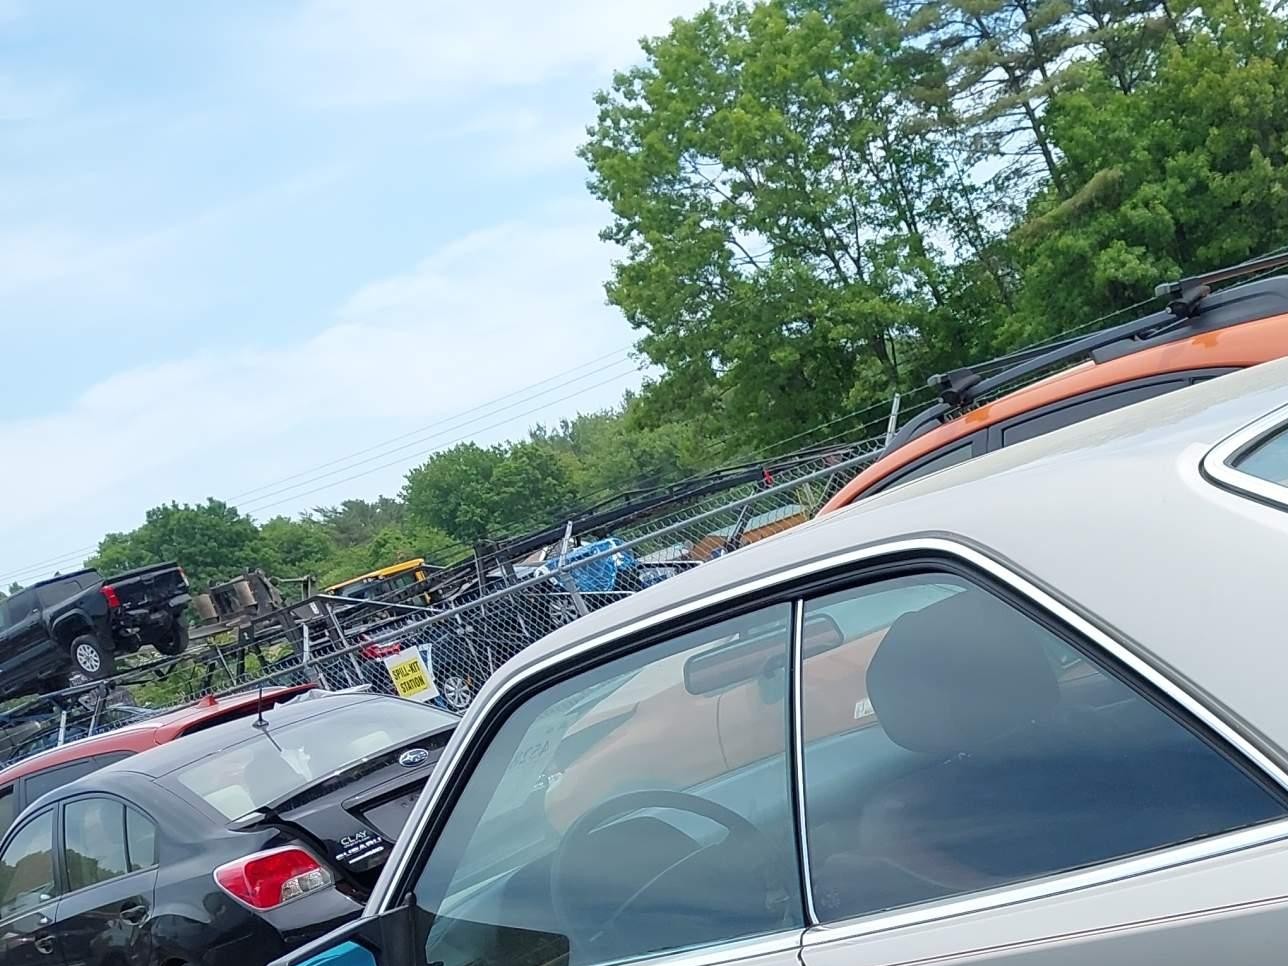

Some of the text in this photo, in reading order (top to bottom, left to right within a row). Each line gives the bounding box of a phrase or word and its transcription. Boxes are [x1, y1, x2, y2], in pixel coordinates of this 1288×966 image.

[392, 661, 420, 680] SPILL-KIT
[400, 676, 426, 693] STATION
[340, 830, 367, 845] CLAY
